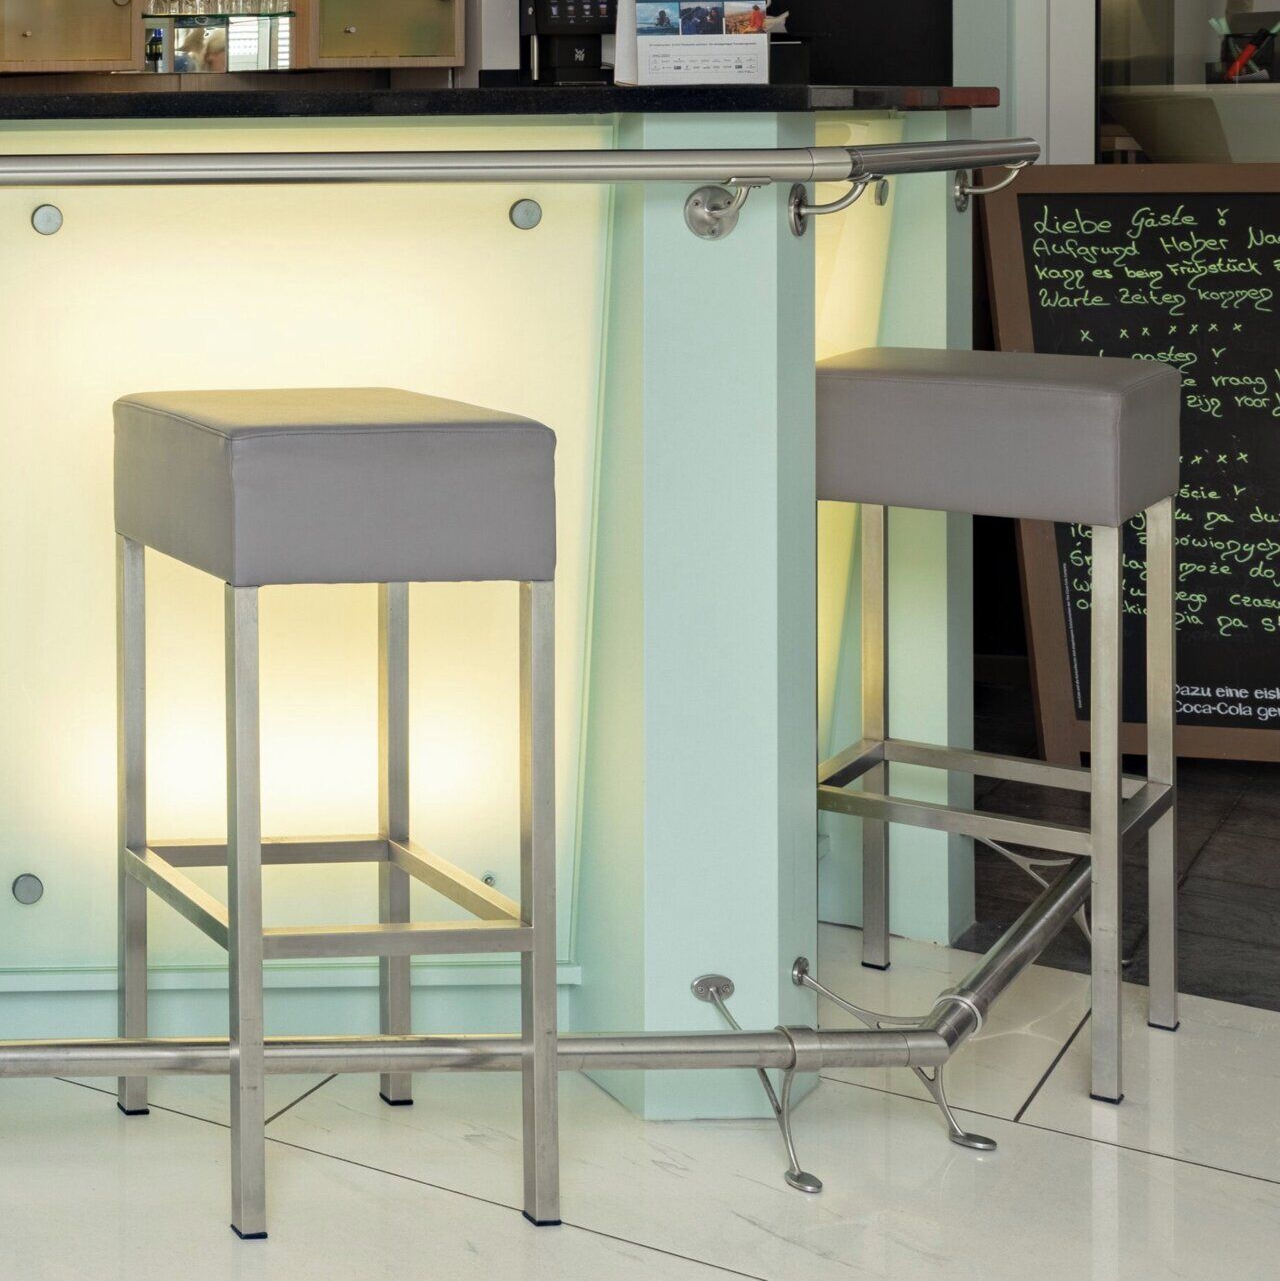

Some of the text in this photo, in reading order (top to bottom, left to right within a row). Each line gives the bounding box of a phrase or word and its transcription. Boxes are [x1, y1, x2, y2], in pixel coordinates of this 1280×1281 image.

[1034, 205, 1112, 234] Liebe
[1126, 205, 1199, 239] Gäste
[1032, 226, 1280, 267] Aufgrund Hoher Na
[1092, 268, 1114, 279] es
[1124, 266, 1163, 289] beim
[1038, 288, 1111, 308] Warte
[1211, 375, 1268, 395] vraag
[1186, 394, 1271, 418] zijn voor
[1215, 685, 1250, 699] eine
[1175, 699, 1253, 717] Coca-Cola
